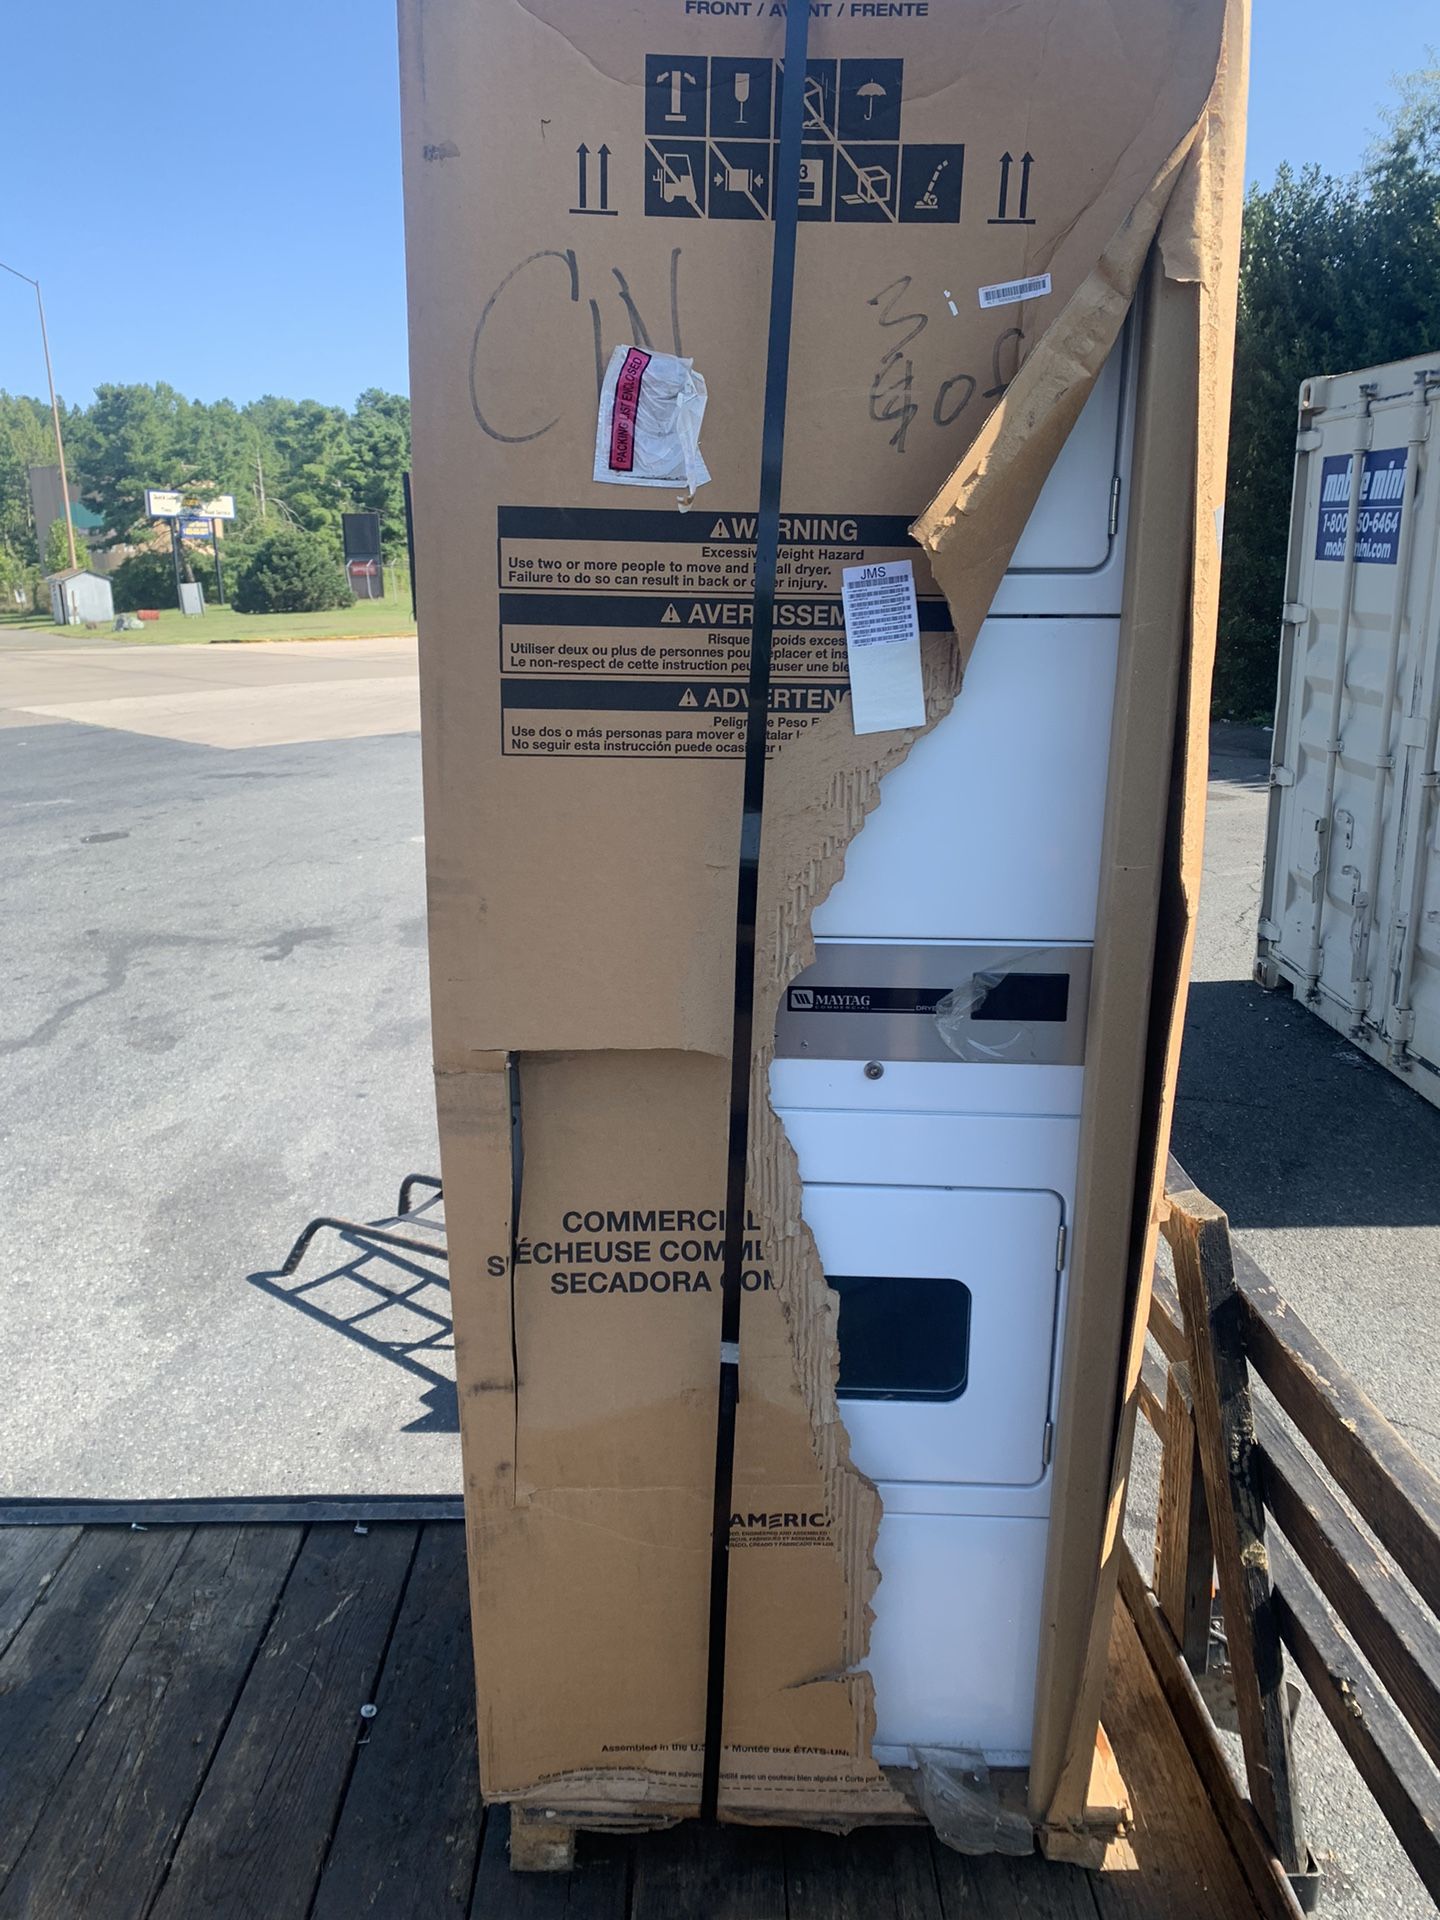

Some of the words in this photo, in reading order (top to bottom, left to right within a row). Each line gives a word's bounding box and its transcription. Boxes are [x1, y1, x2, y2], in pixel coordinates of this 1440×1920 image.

[685, 1, 751, 16] FRONT
[769, 3, 832, 17] ANT
[850, 3, 929, 17] FRENTE
[621, 356, 643, 402] ENCLOSED
[619, 403, 632, 420] LIST
[615, 422, 629, 464] PACKING
[731, 517, 858, 541] WRNING
[702, 546, 758, 559] Excessiv
[818, 548, 864, 561] Hazard
[508, 556, 534, 569] Use
[538, 558, 562, 570] two
[566, 560, 580, 570] or
[584, 561, 617, 571] more
[621, 561, 665, 574] people
[669, 561, 683, 572] to
[687, 562, 721, 573] move
[725, 562, 749, 574] and
[753, 562, 791, 575] iall
[795, 563, 832, 577] dryer.
[860, 566, 886, 580] JMS
[508, 570, 553, 583] Failure
[557, 571, 571, 583] to
[574, 572, 591, 584] do
[595, 575, 611, 584] so
[615, 575, 638, 586] can
[642, 574, 679, 586] result
[683, 575, 694, 586] in
[698, 575, 729, 587] back
[734, 577, 747, 588] or
[788, 577, 828, 591] injury.
[688, 603, 845, 626] AVERISSEM
[708, 633, 749, 647] Risque
[773, 634, 806, 648] poids
[510, 642, 555, 655] Utiliser
[558, 644, 588, 655] deux
[592, 646, 607, 656] ou
[611, 645, 637, 658] plus
[640, 645, 656, 657] de
[659, 647, 724, 660] personnes
[727, 648, 750, 661] pou
[769, 647, 812, 661] placer
[815, 649, 828, 659] et
[511, 656, 526, 668] Le
[529, 657, 605, 671] non-respect
[608, 658, 624, 669] de
[627, 659, 659, 670] cette
[662, 659, 728, 671] instruction
[731, 662, 750, 675] peu
[769, 661, 803, 673] auser
[806, 662, 830, 673] une
[713, 716, 749, 731] Peligr
[779, 716, 807, 729] Peso
[511, 726, 535, 737] Use
[539, 726, 562, 738] dos
[565, 728, 573, 738] o
[576, 727, 602, 738] más
[605, 730, 662, 741] personas
[665, 731, 692, 741] para
[696, 730, 735, 741] mover
[737, 731, 745, 740] e
[511, 738, 529, 750] No
[532, 739, 571, 753] seguir
[574, 740, 600, 751] esta
[604, 739, 672, 752] instrucción
[675, 741, 712, 753] puede
[815, 994, 870, 1006] MAYTAG
[562, 1210, 760, 1233] COMMERCIL
[551, 1270, 712, 1294] SECADORA
[601, 1743, 658, 1753] Assembled
[660, 1743, 669, 1752] in
[671, 1743, 688, 1751] the
